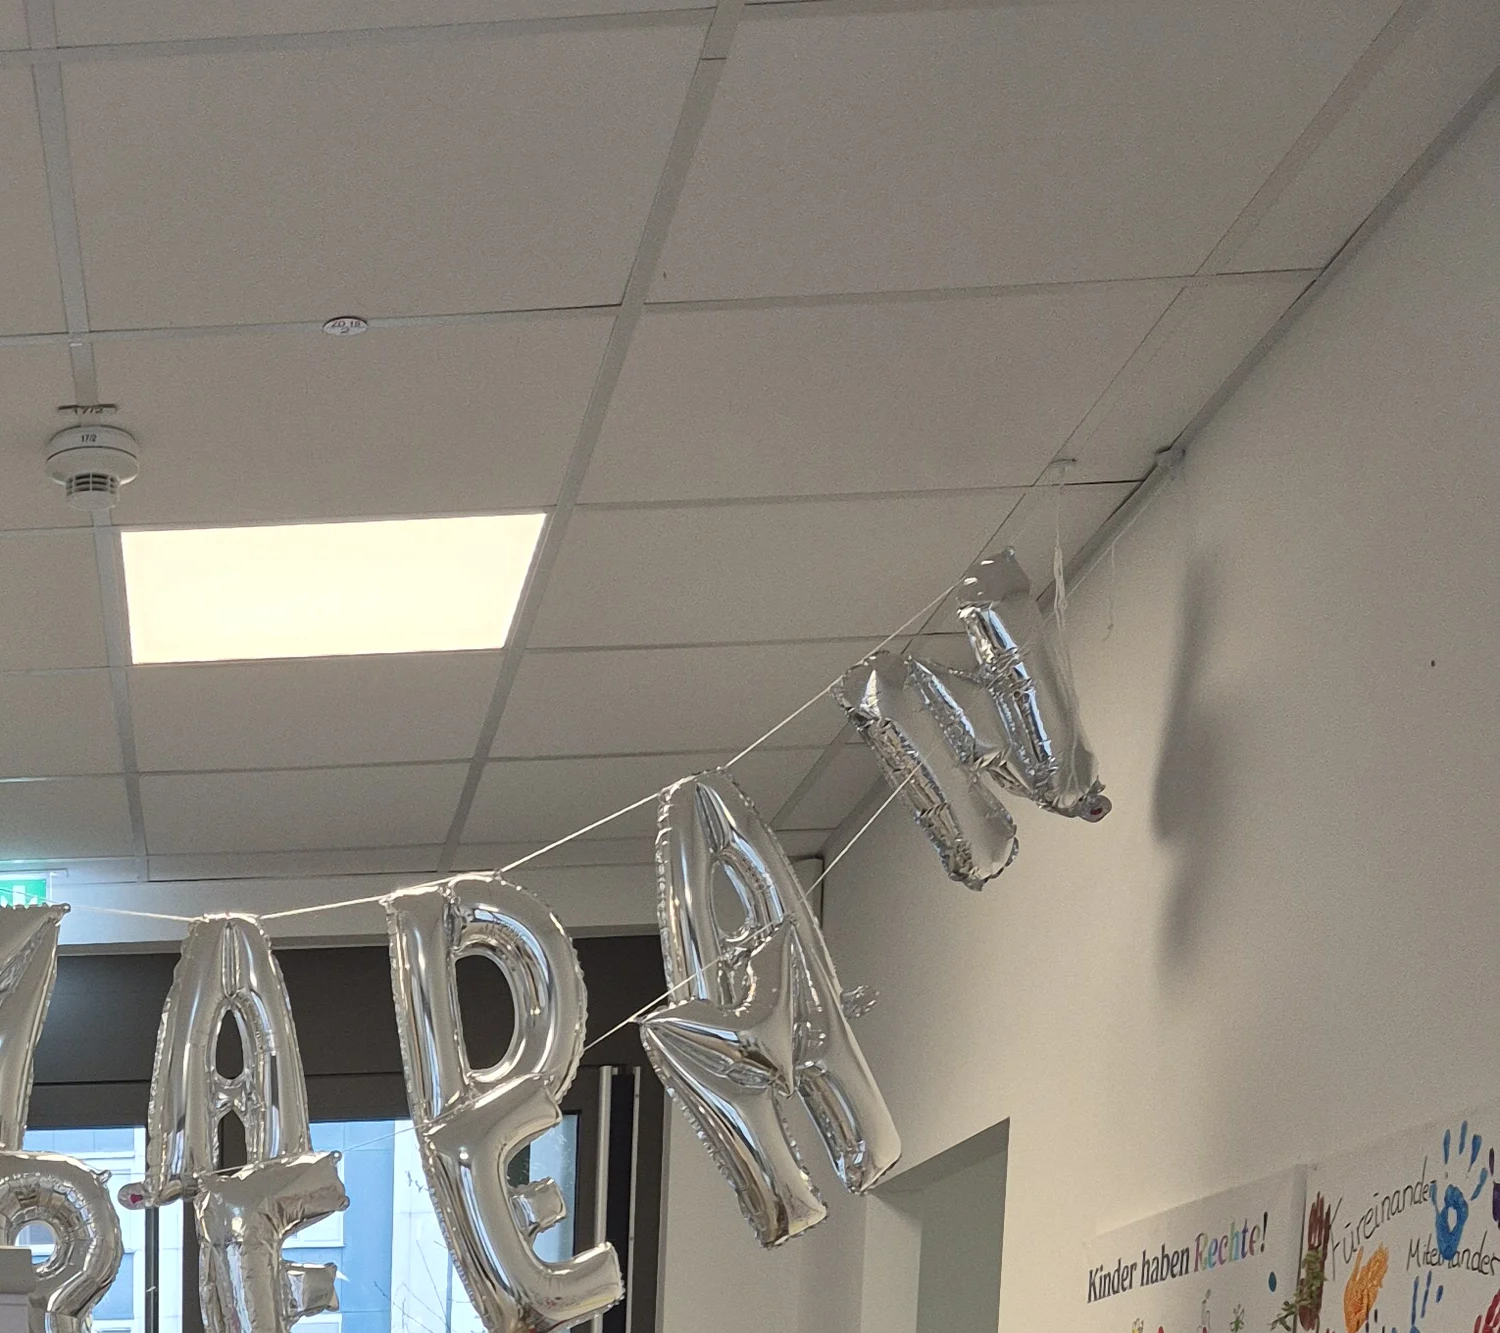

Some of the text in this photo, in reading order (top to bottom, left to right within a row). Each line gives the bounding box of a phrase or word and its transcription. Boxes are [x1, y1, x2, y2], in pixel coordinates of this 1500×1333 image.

[1087, 1210, 1269, 1304] Kinder haben Rechte!
[1406, 1230, 1500, 1276] Miteander
